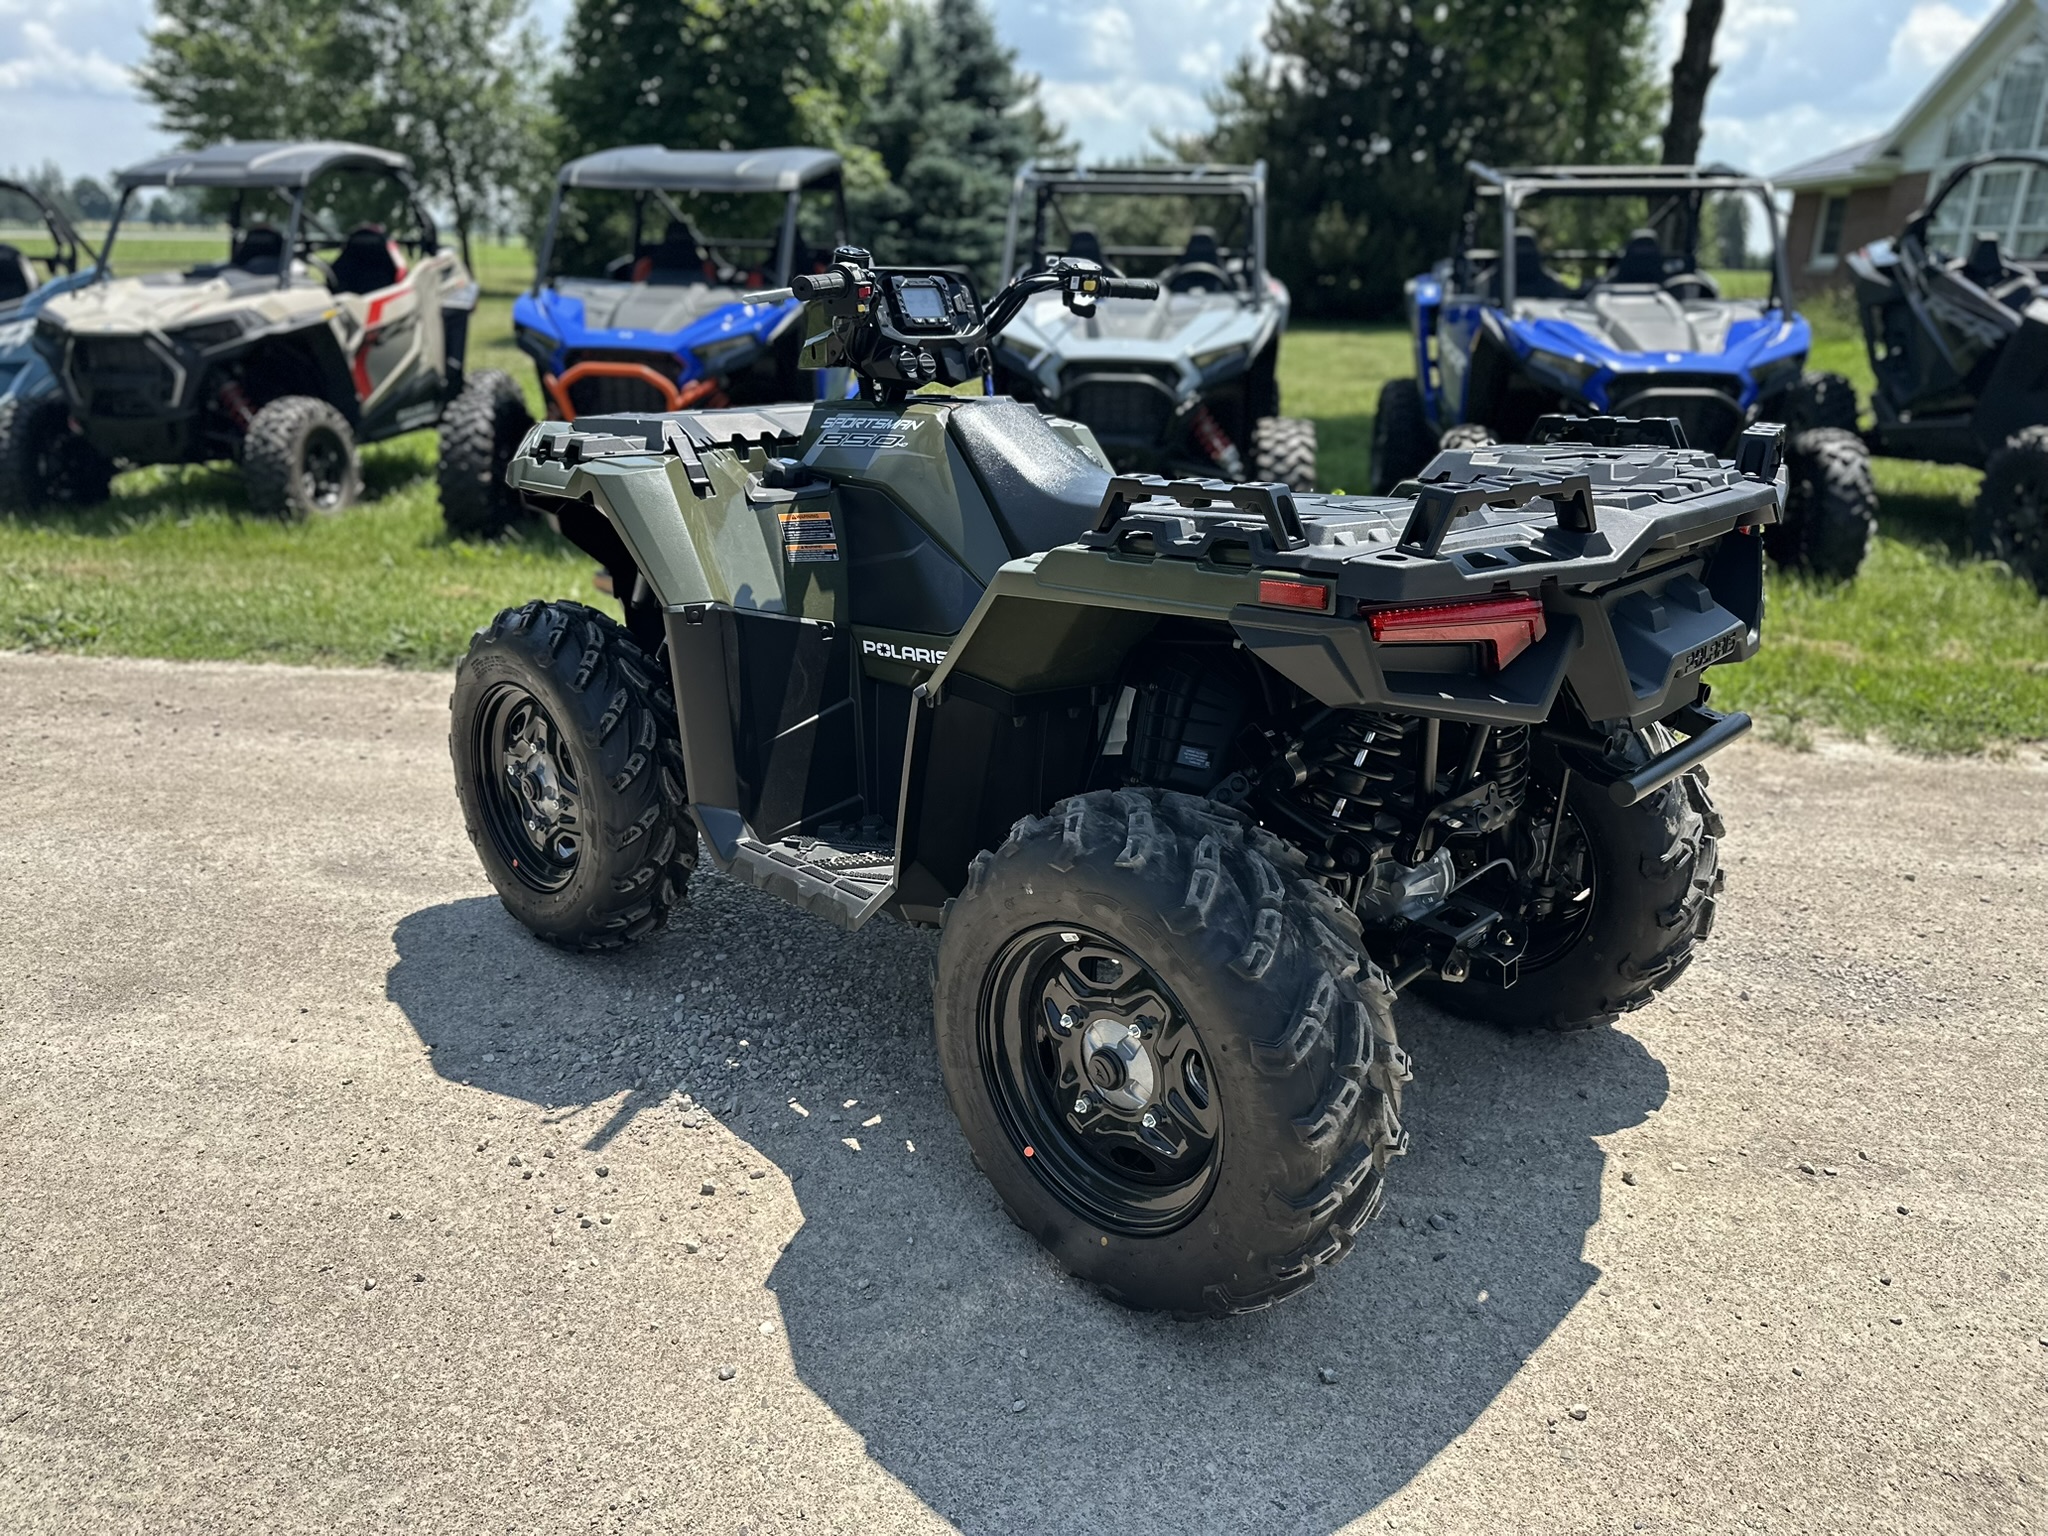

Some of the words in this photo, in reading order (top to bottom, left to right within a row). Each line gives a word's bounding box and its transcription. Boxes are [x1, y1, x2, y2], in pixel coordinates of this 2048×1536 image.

[820, 417, 925, 431] SPORTSMAN
[816, 432, 905, 448] 850
[862, 639, 949, 665] POLARIS
[1684, 631, 1737, 674] POLARIS
